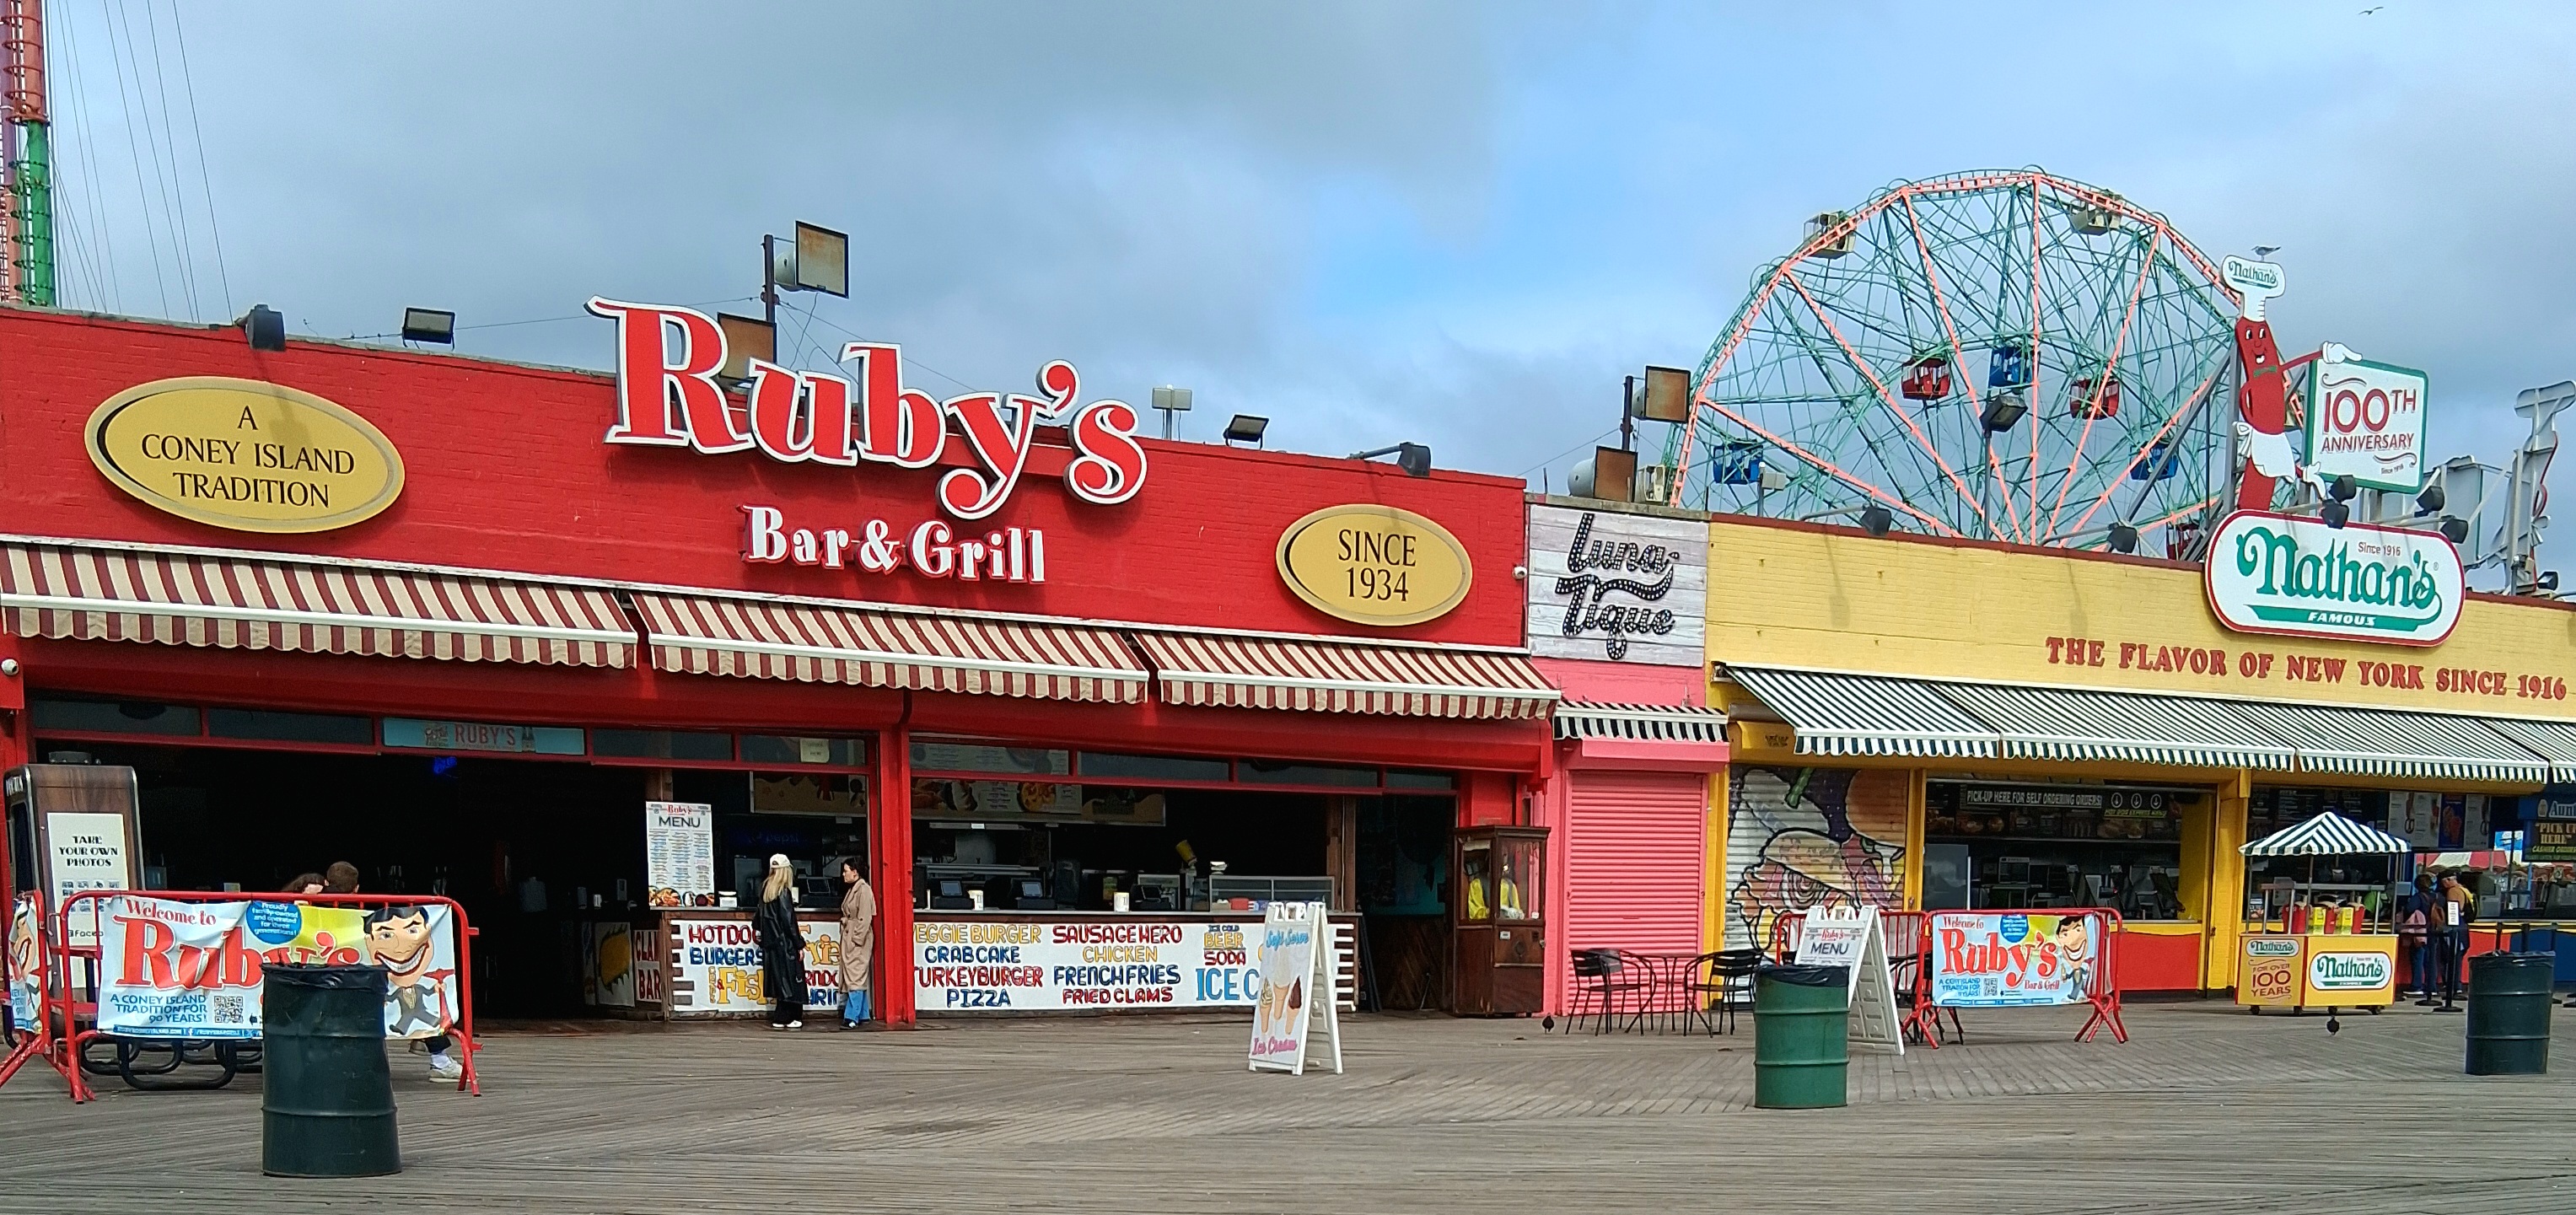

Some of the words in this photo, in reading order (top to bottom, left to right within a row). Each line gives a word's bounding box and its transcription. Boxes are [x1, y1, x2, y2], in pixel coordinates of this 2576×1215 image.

[2229, 261, 2277, 284] Nathan's
[584, 295, 1148, 519] Ruby's
[237, 405, 258, 431] A
[2321, 433, 2415, 454] ANNIVERSARY
[141, 433, 241, 465] CONEY
[255, 443, 355, 475] ISLAND
[172, 472, 330, 508] TRADITION
[1337, 528, 1417, 567] SINCE
[2358, 541, 2381, 554] Since
[2383, 546, 2401, 556] 1916
[2235, 526, 2436, 610] Nathan's
[1346, 567, 1409, 602] 1934
[1555, 573, 1676, 661] Tique
[2307, 611, 2377, 626] FAMOUS
[2046, 637, 2105, 668] THE
[2119, 642, 2227, 676] FLAVOR
[2240, 651, 2275, 679] OF
[2286, 655, 2347, 685] NEW
[2358, 660, 2425, 691] YORK
[2436, 668, 2507, 696] SINCE
[2518, 674, 2567, 701] 1916
[454, 723, 516, 746] RUBY'S
[1967, 790, 1993, 802] PICK-UP
[1993, 791, 2012, 803] HERE
[2012, 792, 2025, 804] FOR
[2026, 793, 2042, 804] SELF
[2042, 793, 2075, 805] ORDERING
[659, 816, 701, 828] MENU
[73, 835, 103, 845] TAKE
[59, 847, 88, 856] YOUR
[90, 847, 118, 856] OWN
[67, 857, 112, 868] PHOTOS
[127, 899, 196, 925] Welcome
[199, 909, 218, 926] to
[914, 924, 968, 944] EGGIE
[971, 924, 1042, 944] BURGER
[1208, 925, 1221, 933] ICE
[1204, 932, 1245, 949] BEER
[1810, 942, 1850, 954] MENU
[2251, 940, 2294, 953] Nathan's
[924, 946, 975, 964] CRAB
[976, 946, 1021, 964] CAKE
[1082, 945, 1159, 964] CHICKEN
[1203, 950, 1247, 966] SODA
[1939, 927, 2057, 989] Ruby's
[1053, 965, 1124, 987] FRENCH
[1126, 965, 1181, 986] FRIES
[2316, 954, 2384, 979] Nathan's
[1196, 967, 1240, 1002] ICE
[2025, 980, 2036, 990] Bar
[2044, 980, 2060, 991] Grill
[2251, 970, 2292, 987] 100
[110, 993, 120, 1003] A
[122, 995, 163, 1005] CONEY
[165, 994, 207, 1004] ISLAND
[946, 988, 1012, 1008] PIZZA
[1062, 988, 1111, 1005] FRIED
[1113, 987, 1174, 1004] CLAMS
[2251, 986, 2292, 997] YEARS
[115, 1003, 181, 1013] TRADITION
[183, 1003, 207, 1013] FOR
[148, 1014, 164, 1024] 90
[164, 1013, 207, 1024] YEARS!
[1251, 1037, 1266, 1056] Ice
